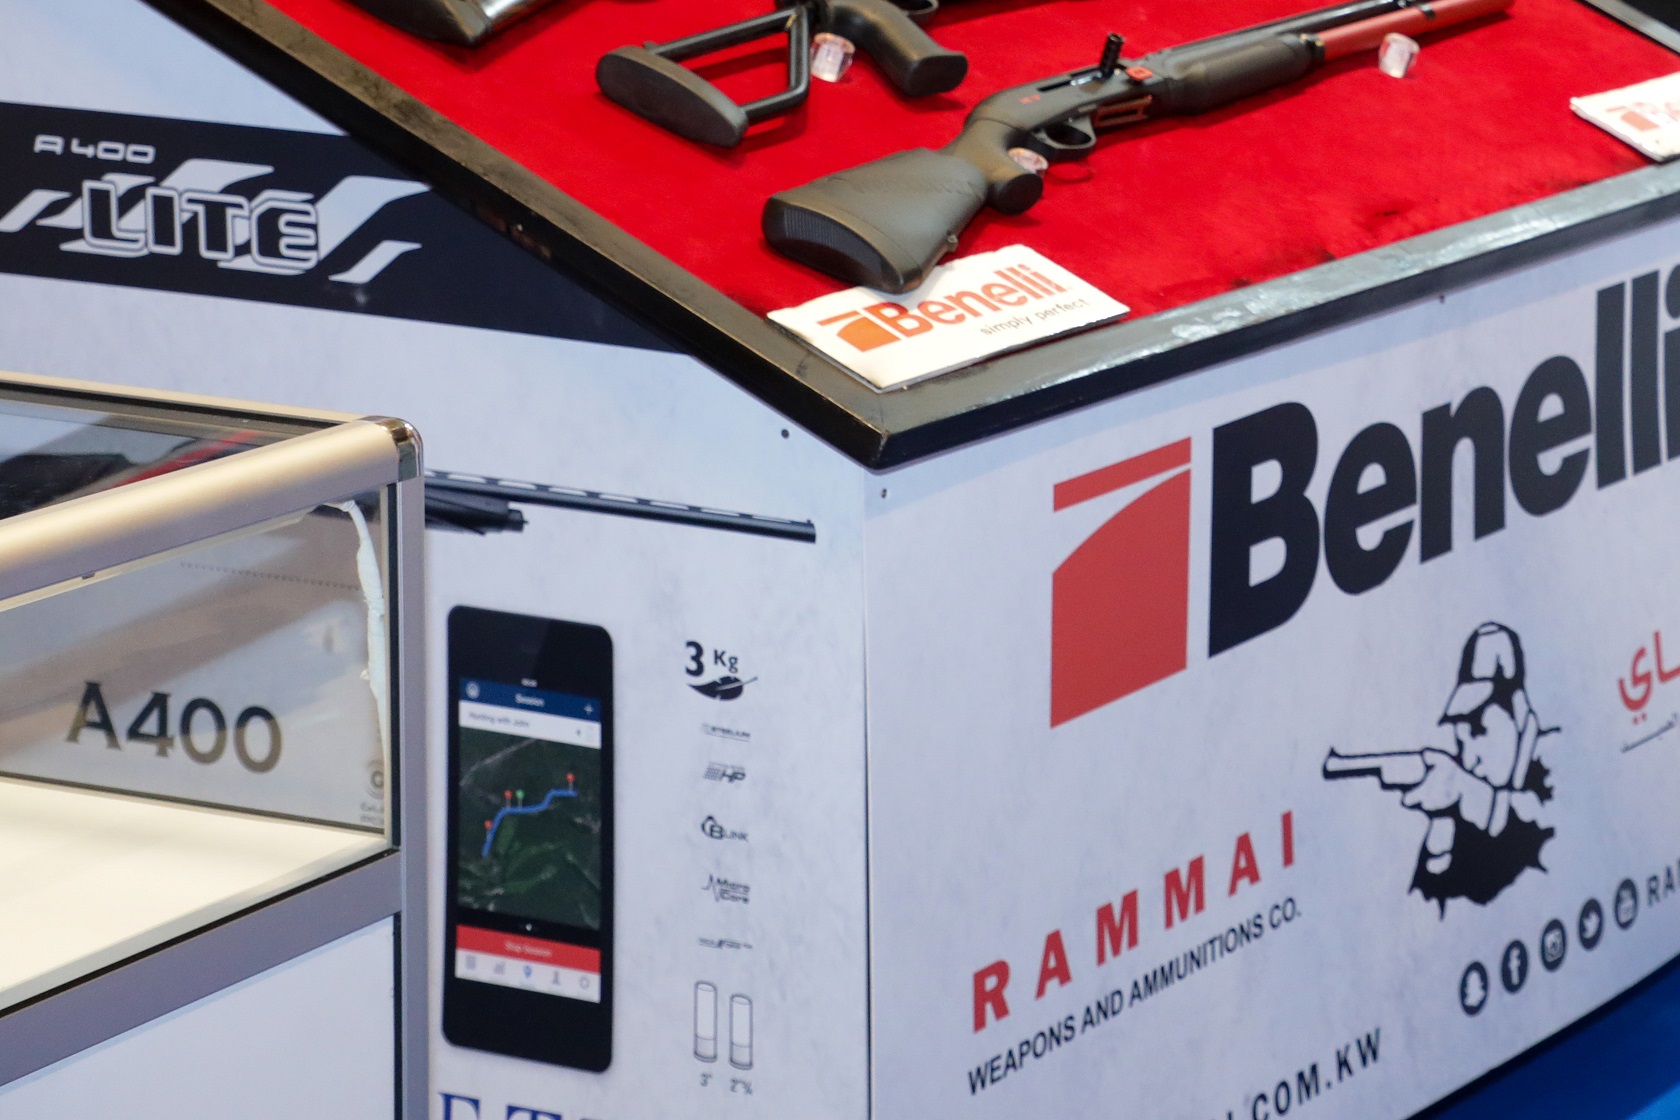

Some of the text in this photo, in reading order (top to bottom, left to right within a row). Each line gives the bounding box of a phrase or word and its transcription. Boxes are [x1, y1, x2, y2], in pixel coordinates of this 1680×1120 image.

[81, 179, 320, 272] LITE
[861, 263, 1067, 338] Benelli
[980, 297, 1091, 337] simply perfect
[685, 640, 739, 678] 3 Kg
[63, 680, 284, 774] A400
[972, 810, 1296, 1035] RAMMAI
[967, 897, 1302, 1097] WEAPONS AND AMMUNITIONS CO.
